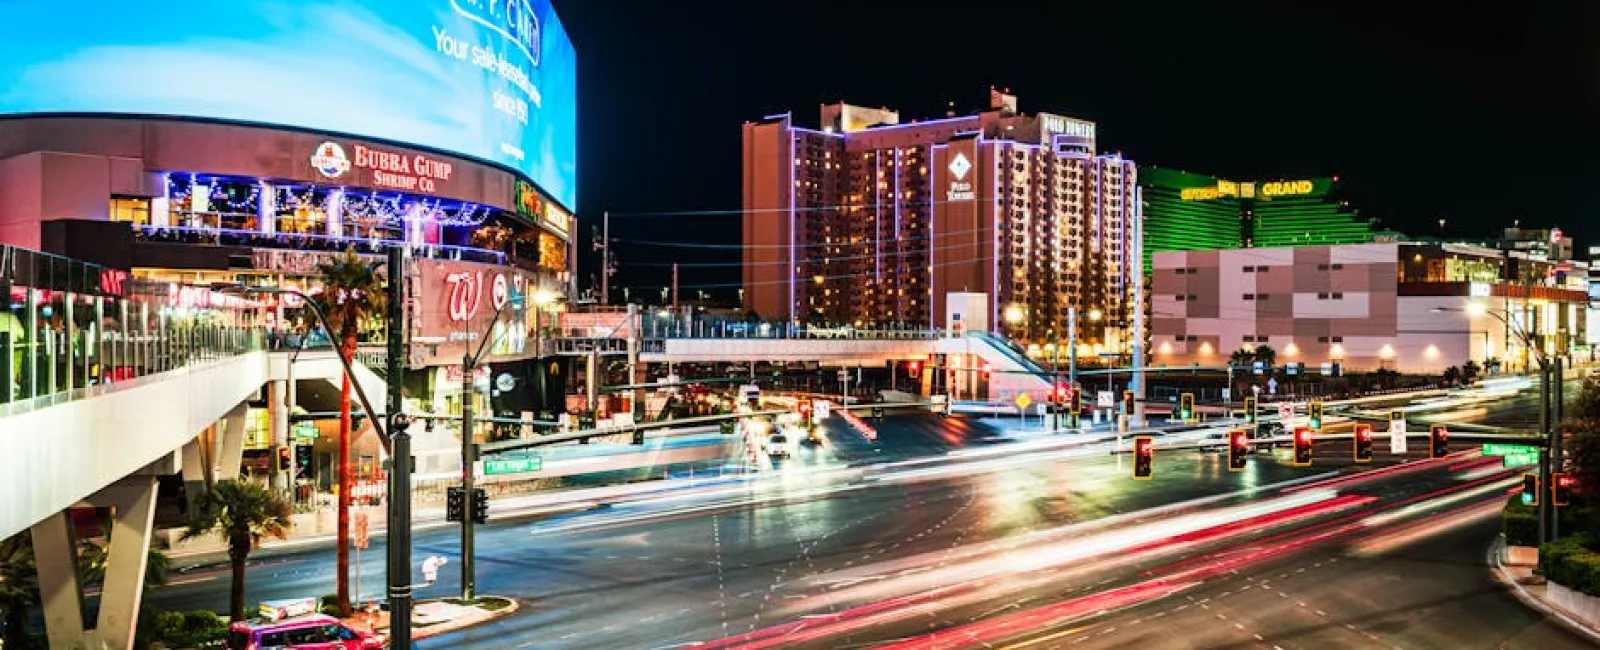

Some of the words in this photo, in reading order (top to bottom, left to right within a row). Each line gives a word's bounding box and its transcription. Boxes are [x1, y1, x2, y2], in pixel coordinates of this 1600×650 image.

[432, 24, 469, 61] Your
[353, 144, 411, 173] BUBBA
[414, 155, 452, 180] GUMP
[373, 170, 418, 190] SHRIMP
[1262, 180, 1313, 196] GRAND
